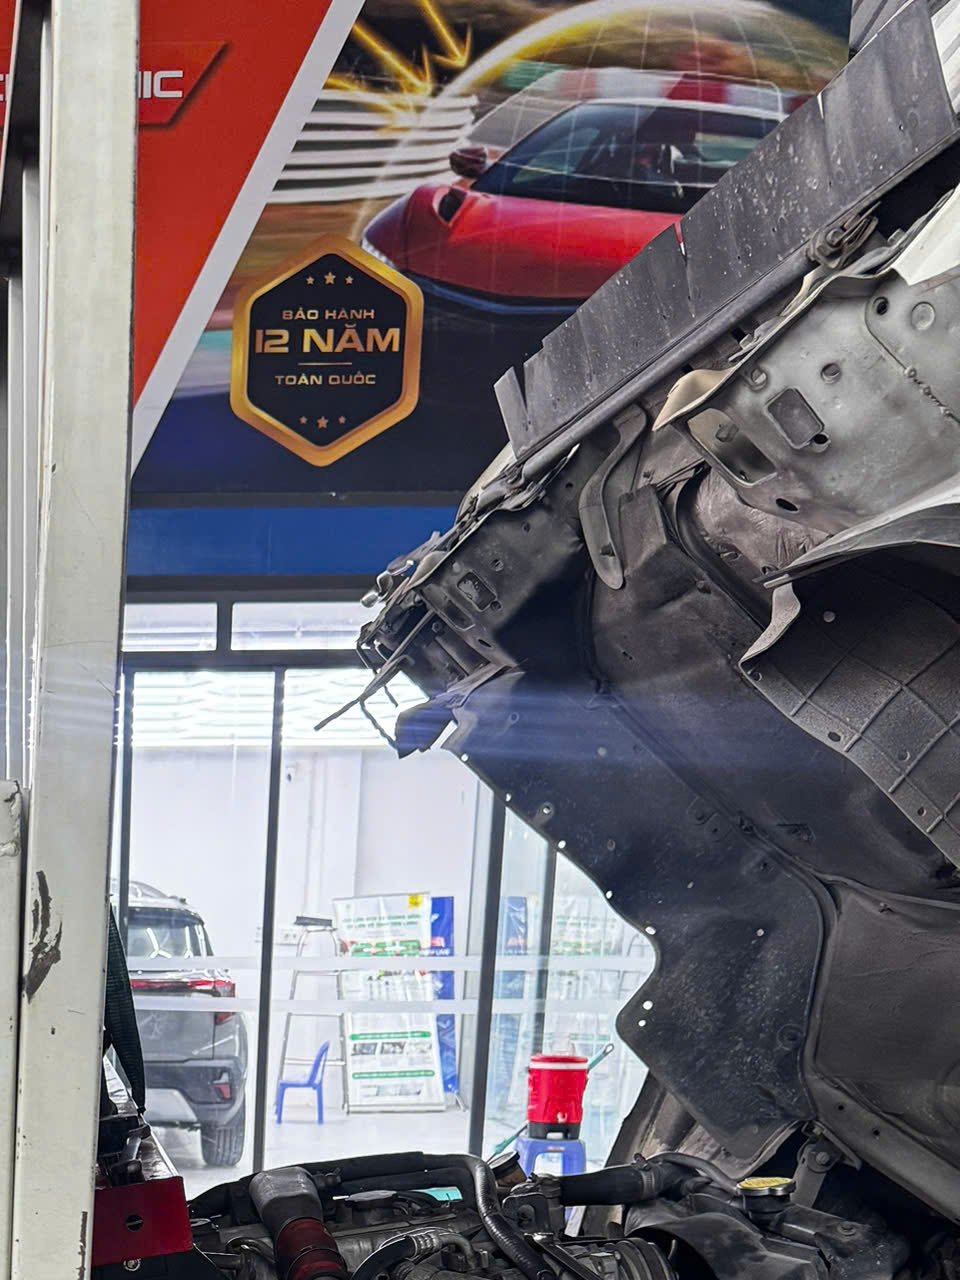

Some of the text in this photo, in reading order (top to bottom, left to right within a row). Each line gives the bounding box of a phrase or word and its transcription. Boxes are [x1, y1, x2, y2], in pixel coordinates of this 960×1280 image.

[282, 307, 375, 320] BẢO HÀNH
[255, 323, 400, 353] 12 NĂM
[275, 373, 323, 385] TOÀN
